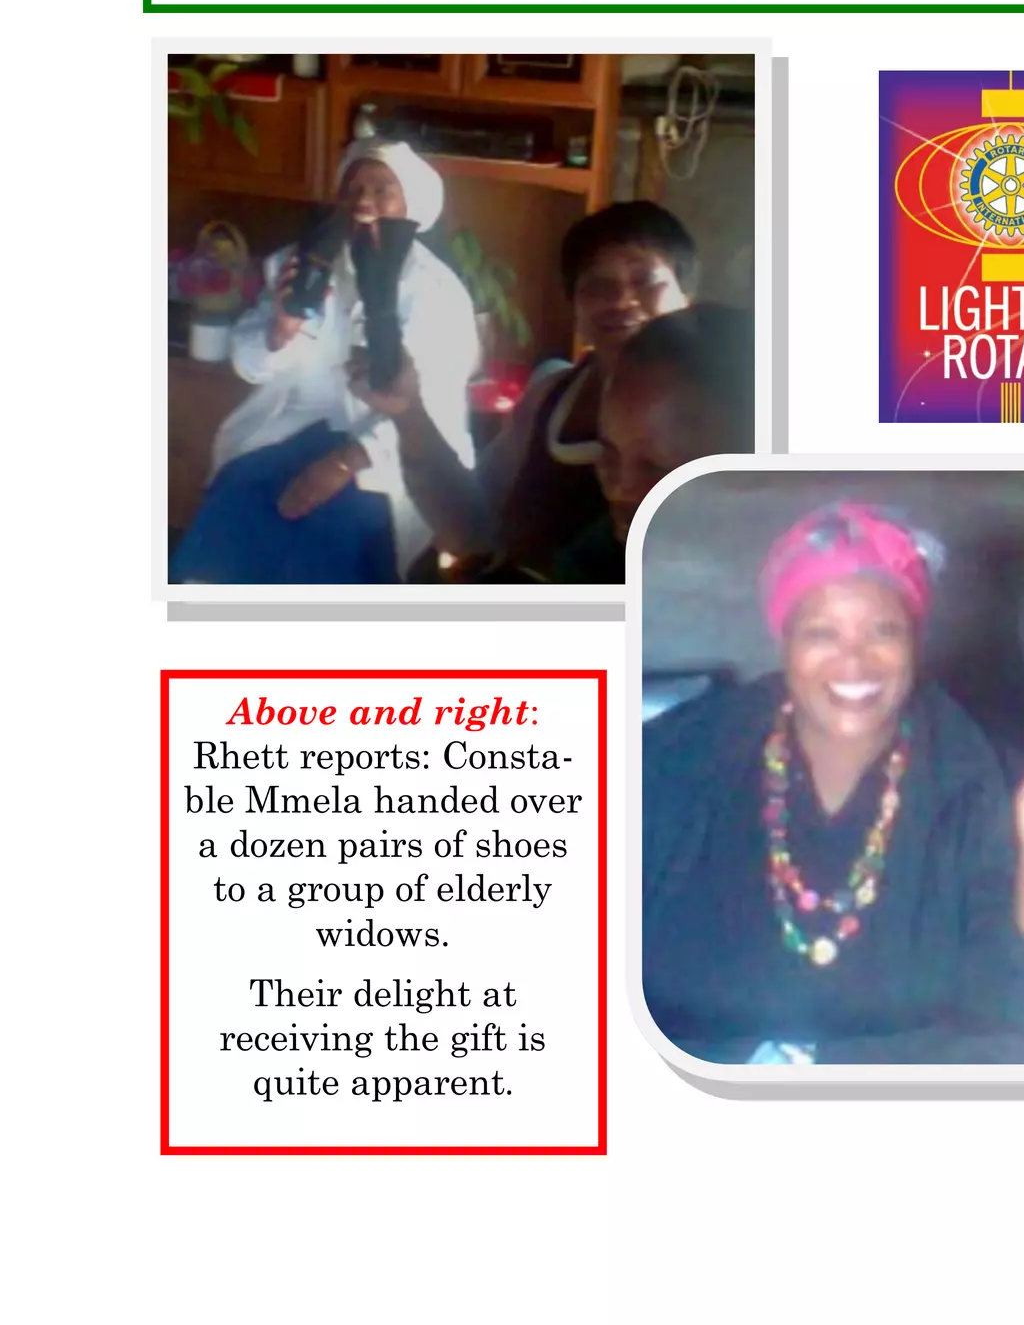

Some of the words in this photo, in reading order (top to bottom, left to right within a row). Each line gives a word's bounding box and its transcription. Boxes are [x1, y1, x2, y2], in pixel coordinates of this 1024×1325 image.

[224, 696, 337, 726] Above
[349, 696, 423, 726] and
[434, 696, 538, 732] right:
[193, 740, 289, 770] Rhett
[299, 743, 429, 777] reports:
[443, 740, 573, 770] Consta-
[183, 784, 234, 814] ble
[244, 784, 363, 814] Mmela
[373, 784, 500, 814] handed
[510, 794, 583, 814] over
[198, 838, 218, 858] a
[230, 829, 327, 858] dozen
[337, 829, 423, 865] pairs
[434, 828, 468, 858] of
[475, 829, 568, 859] shoes
[213, 876, 246, 903] to
[257, 882, 277, 903] a
[287, 882, 385, 909] group
[395, 872, 429, 903] of
[436, 873, 553, 909] elderly
[315, 918, 449, 948] widows.
[249, 978, 343, 1008] Their
[353, 978, 472, 1015] delight
[482, 981, 517, 1008] at
[219, 1022, 374, 1059] receiving
[384, 1022, 439, 1052] the
[450, 1022, 508, 1059] gift
[518, 1022, 546, 1052] is
[253, 1066, 339, 1103] quite
[351, 1070, 512, 1103] apparent.
